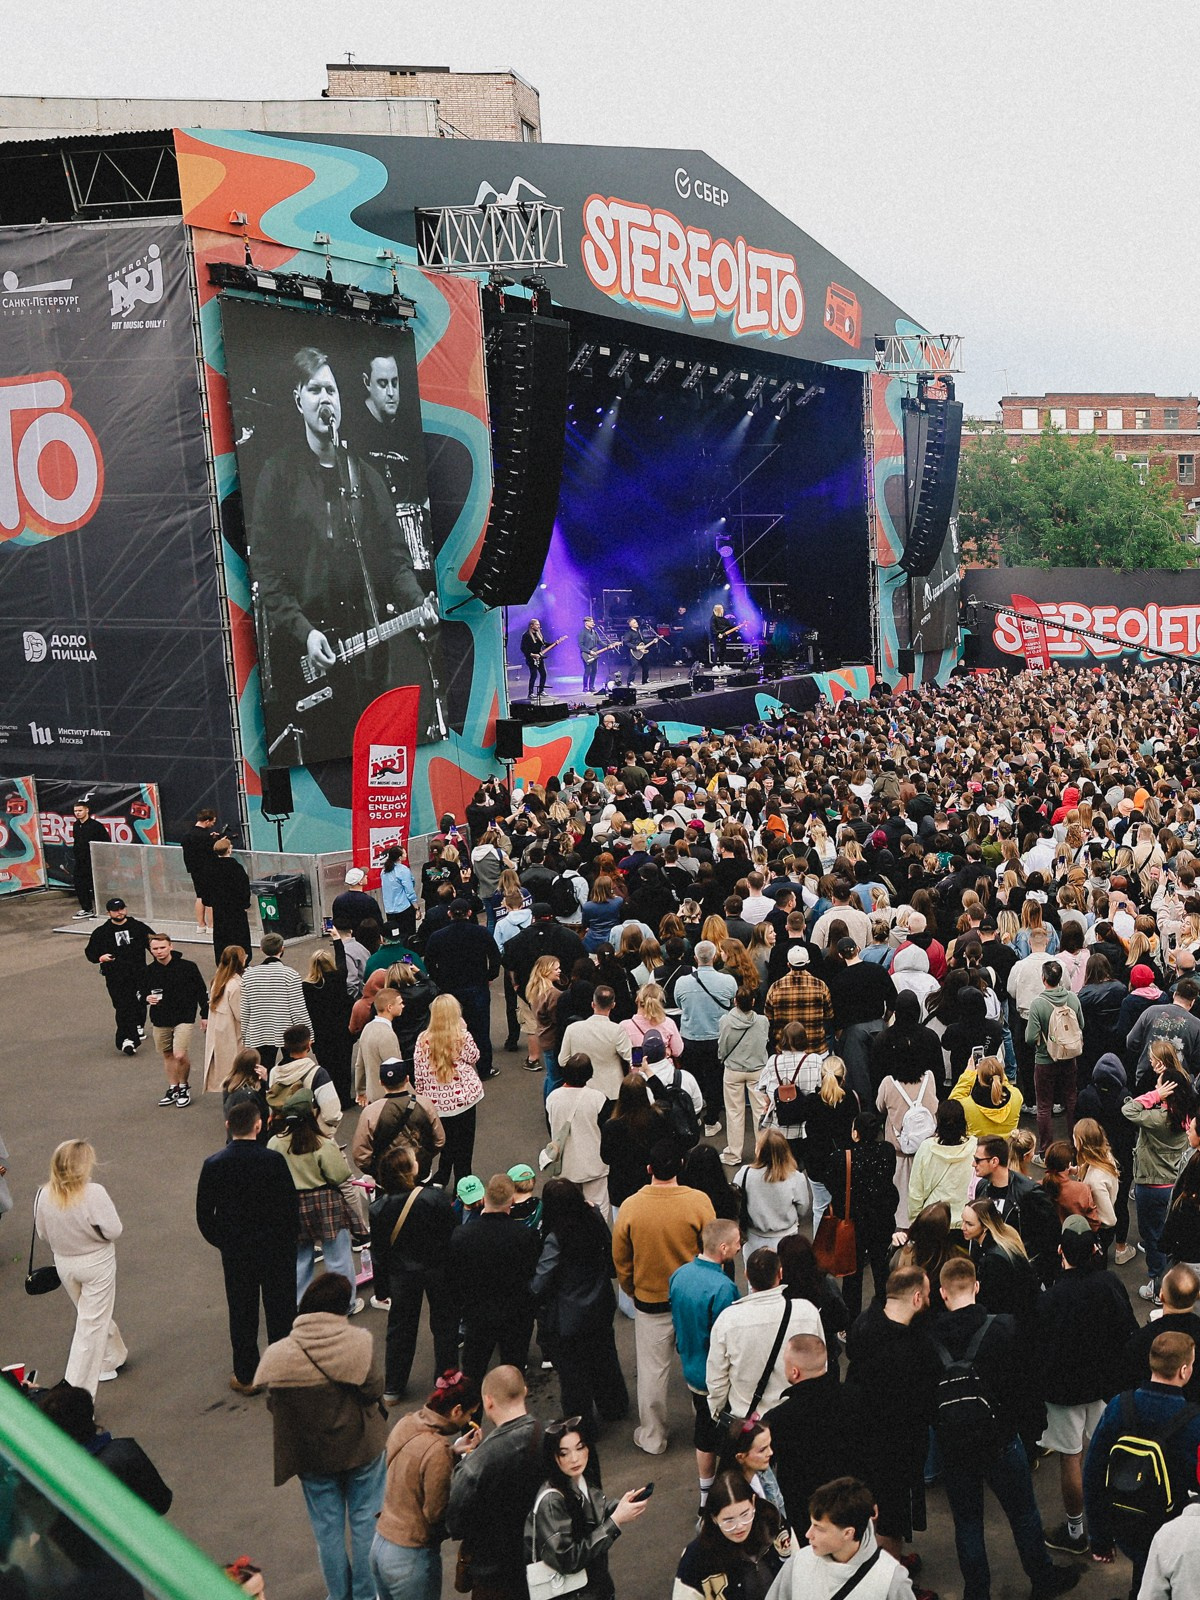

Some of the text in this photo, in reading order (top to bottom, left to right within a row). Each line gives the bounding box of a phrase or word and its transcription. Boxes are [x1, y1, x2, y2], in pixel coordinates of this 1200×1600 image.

[693, 179, 730, 208] СБЕР
[107, 256, 148, 282] ENERGY
[582, 196, 805, 336] STEREOLETO
[108, 244, 164, 318] NRJ
[111, 321, 122, 330] HIT
[123, 321, 144, 329] MUSIC
[50, 634, 87, 648] ДОДО
[51, 648, 97, 662] ПИЦЦА
[57, 727, 111, 737] Институт Листа
[59, 736, 84, 745] Москва
[370, 748, 405, 780] NRJ
[368, 792, 408, 803] СЛУШАЙ
[368, 802, 407, 811] ENERGY
[369, 811, 407, 820] 95.0 FM
